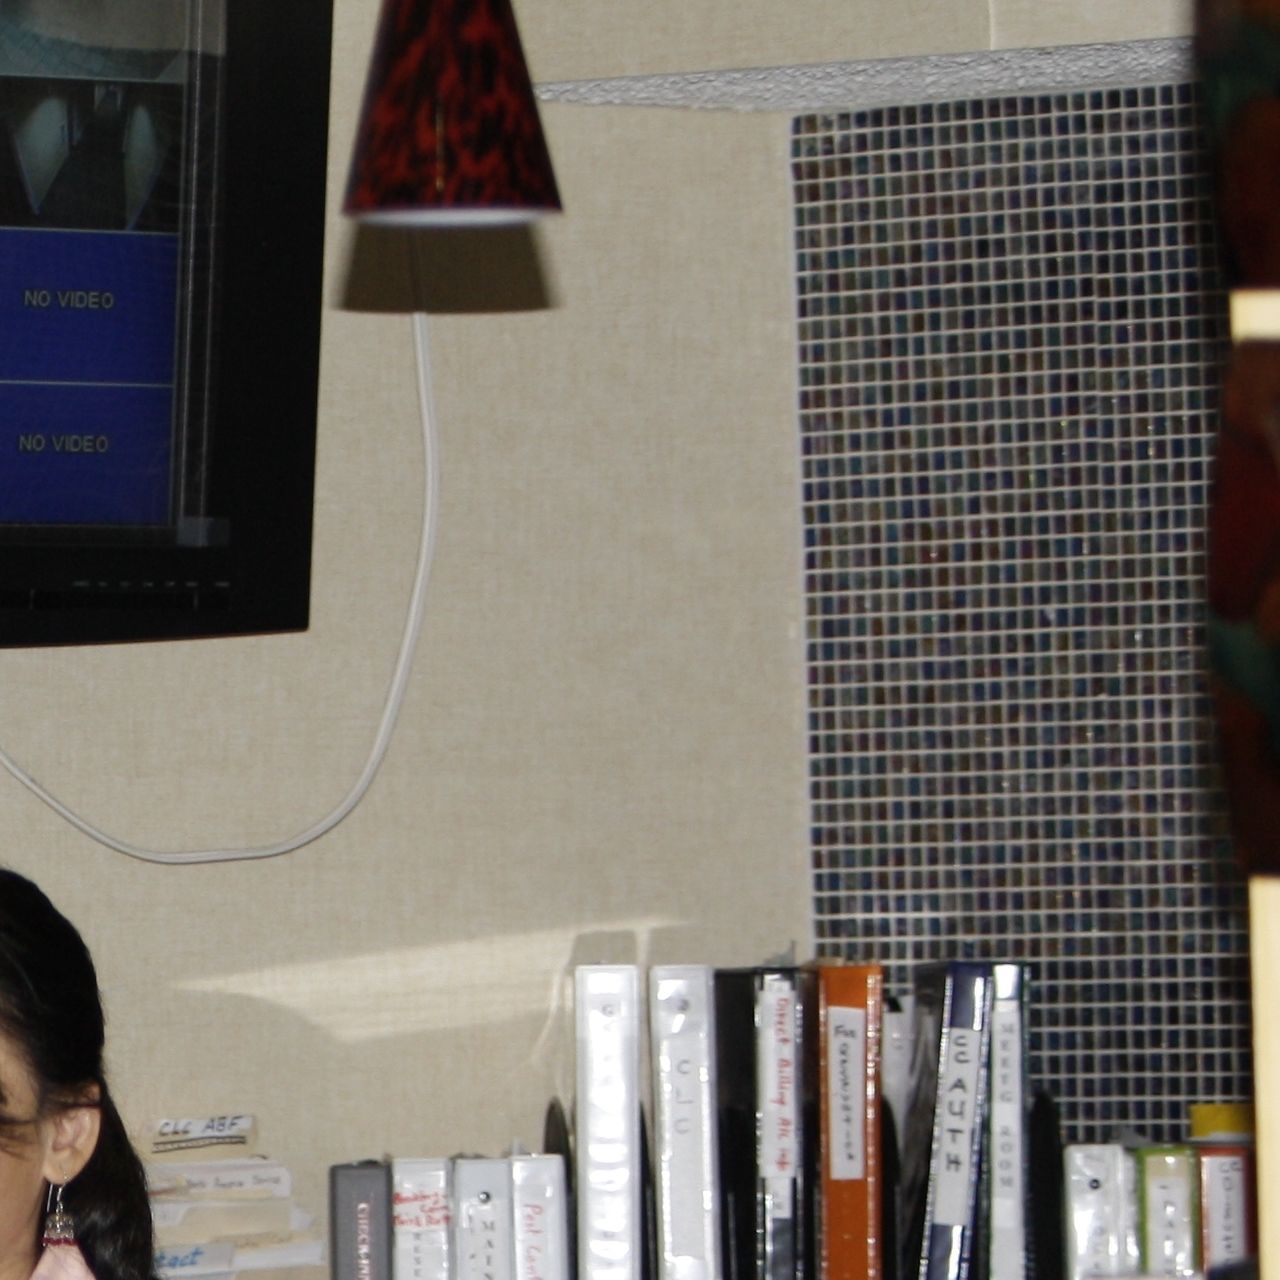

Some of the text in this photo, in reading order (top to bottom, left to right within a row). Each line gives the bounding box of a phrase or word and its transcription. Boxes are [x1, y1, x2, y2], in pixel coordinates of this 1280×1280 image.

[24, 290, 115, 310] NO VIDEO
[19, 435, 108, 452] NO VIDEO
[998, 1126, 1015, 1188] ROOM
